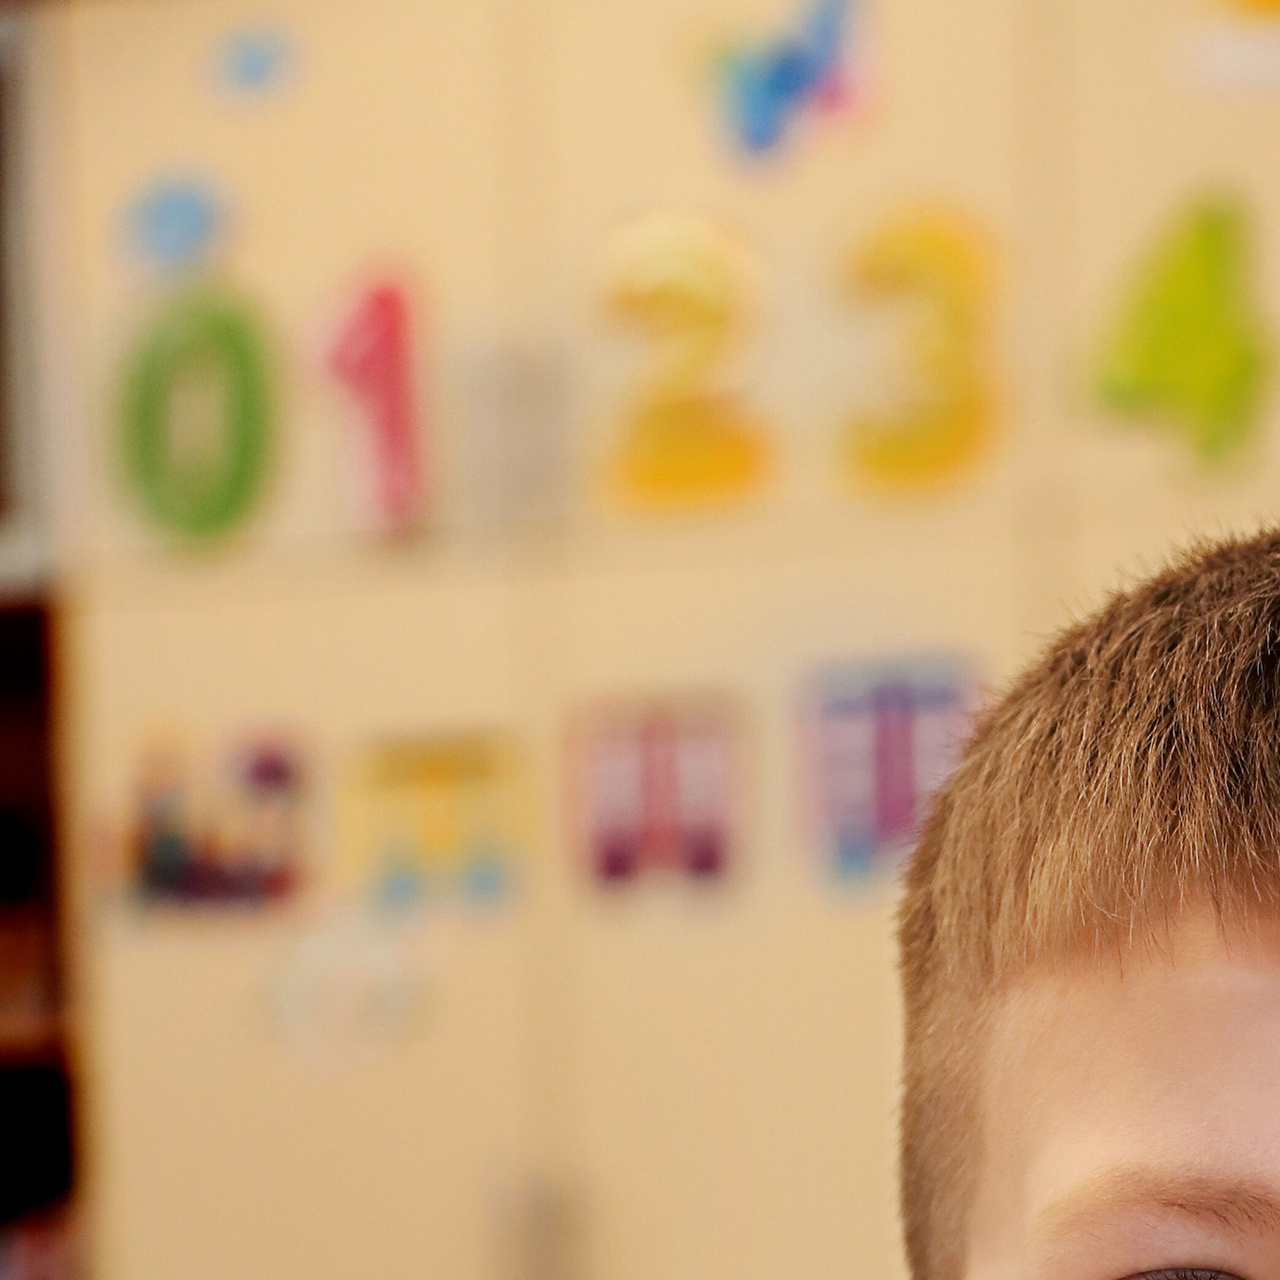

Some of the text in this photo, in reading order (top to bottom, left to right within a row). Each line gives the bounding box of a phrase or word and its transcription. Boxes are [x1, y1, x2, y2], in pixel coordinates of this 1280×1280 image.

[114, 280, 276, 543] 0
[322, 270, 422, 535] 1
[597, 214, 770, 506] 2
[842, 200, 995, 493] 3
[1095, 192, 1270, 462] 4
